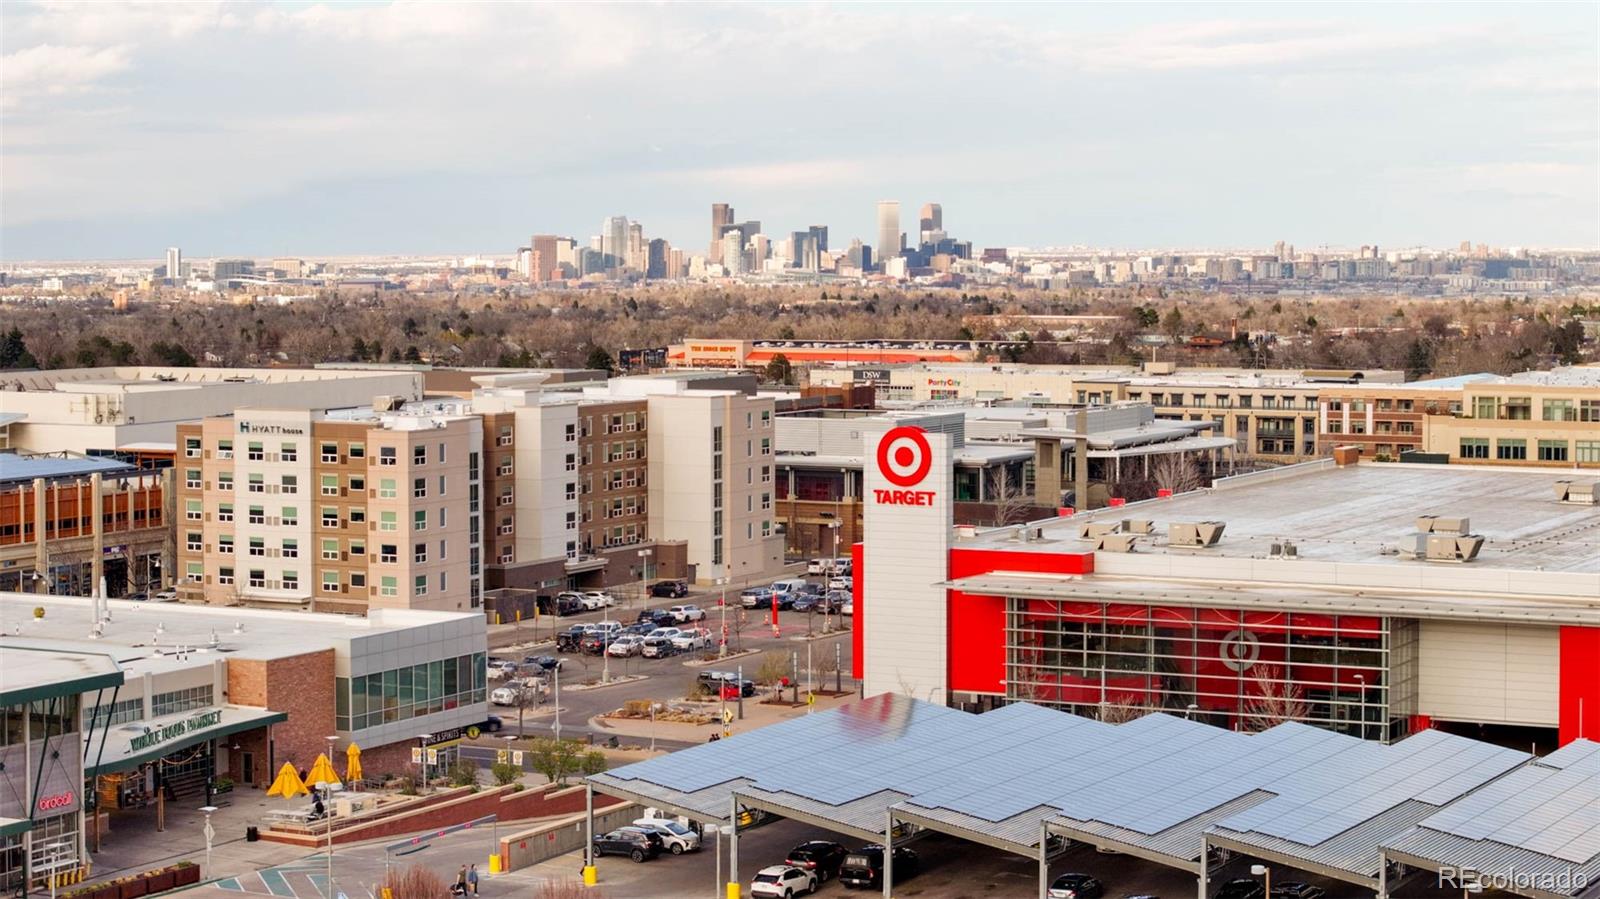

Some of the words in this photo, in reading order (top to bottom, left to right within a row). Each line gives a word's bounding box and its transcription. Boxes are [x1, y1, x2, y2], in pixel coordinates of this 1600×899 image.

[863, 371, 880, 379] DSW
[252, 425, 281, 433] HYATT
[873, 489, 936, 506] TARGET
